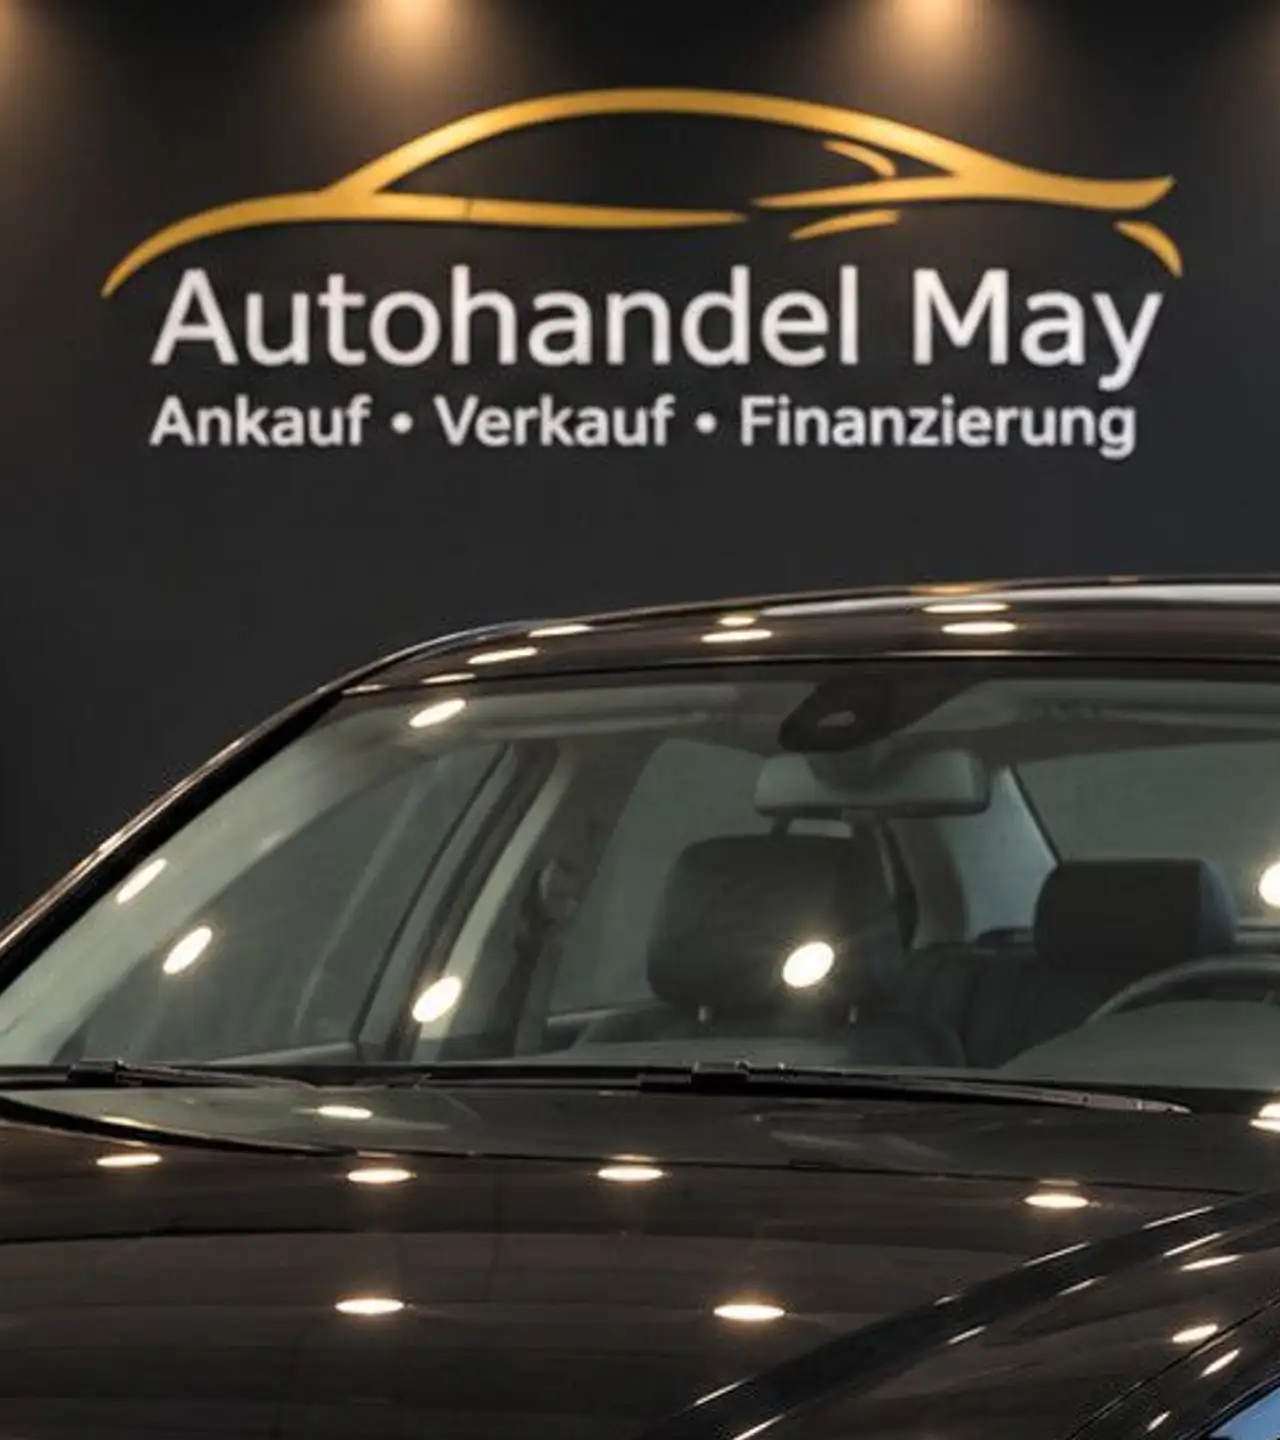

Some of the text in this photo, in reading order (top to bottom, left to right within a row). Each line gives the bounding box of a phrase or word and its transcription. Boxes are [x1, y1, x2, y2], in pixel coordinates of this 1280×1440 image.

[151, 266, 1162, 390] Autohandel May
[150, 392, 1136, 459] Ankauf Verkauf Finanzierung
